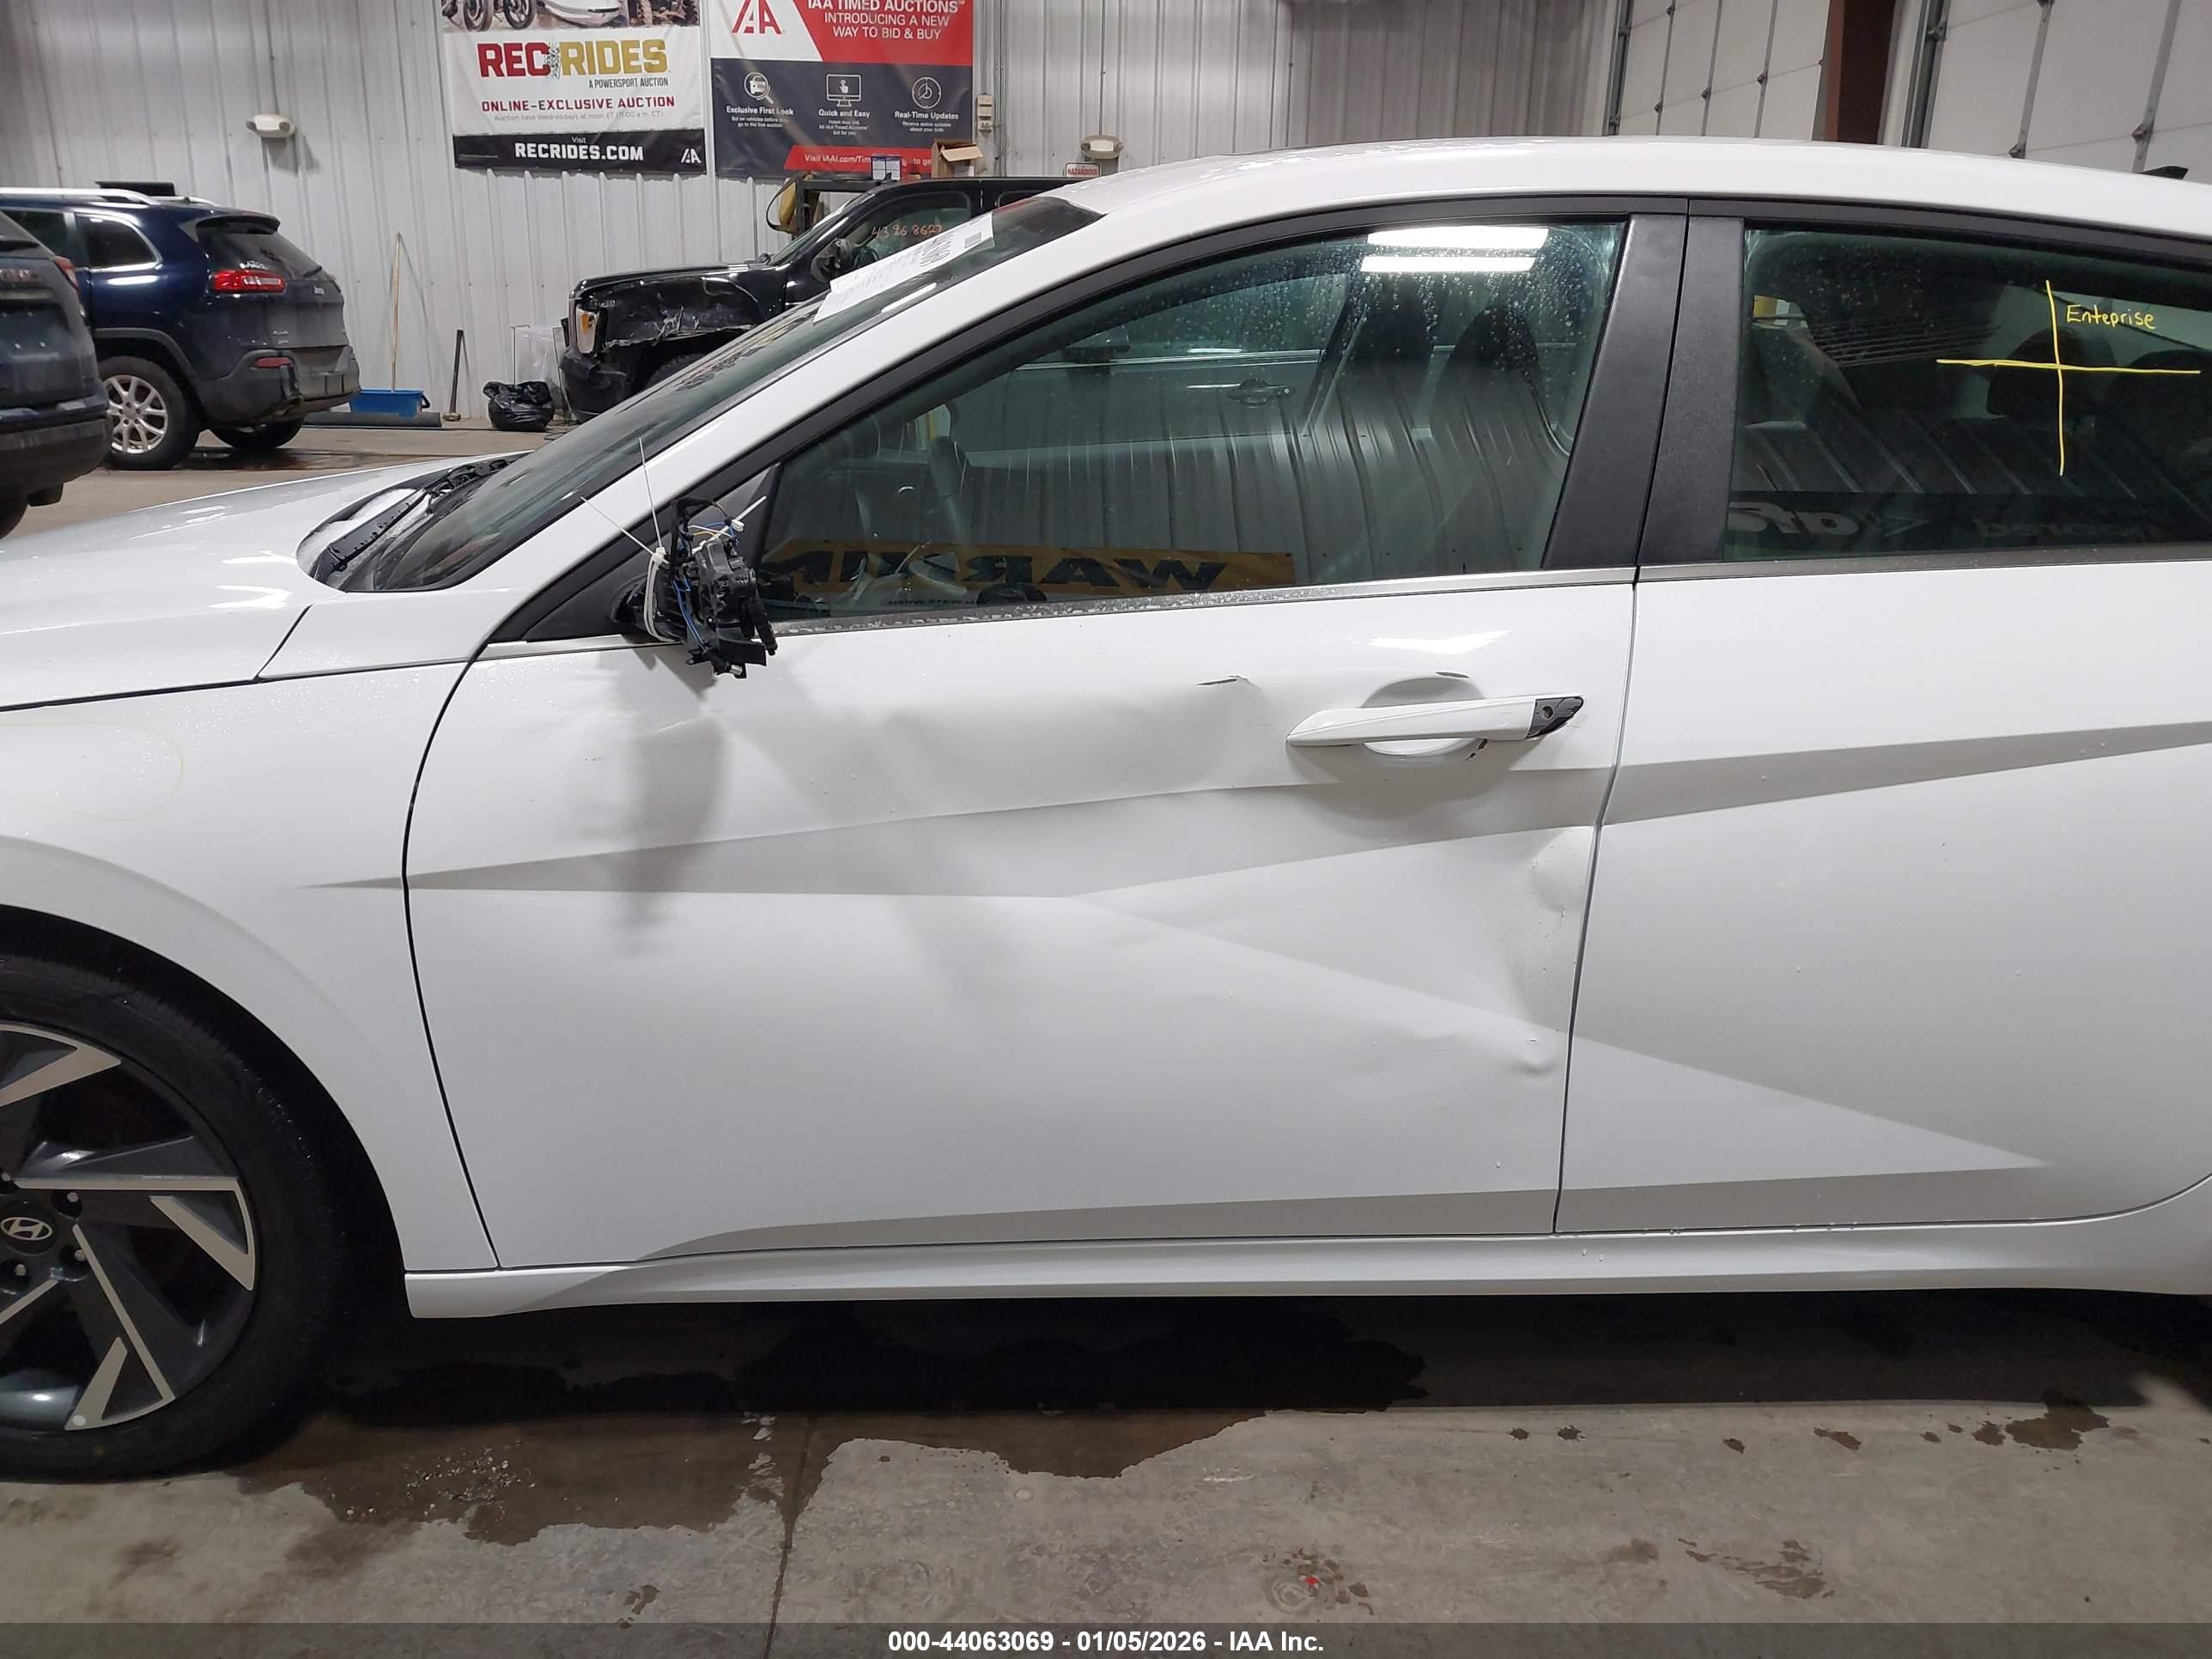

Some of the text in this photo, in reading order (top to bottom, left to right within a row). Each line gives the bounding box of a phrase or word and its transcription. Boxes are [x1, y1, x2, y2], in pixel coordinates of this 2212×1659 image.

[838, 0, 880, 11] TIMED
[884, 0, 958, 13] AUCTIONS
[824, 11, 949, 27] INTRODUCING A NEW
[832, 26, 942, 40] WAY TO BID & BUY
[588, 76, 668, 88] A POWERSPORT AUCTION
[482, 96, 674, 112] ONLINE-EXCLUSIVE AUCTION
[726, 106, 793, 116] Exclusive First Look
[818, 108, 838, 117] Quick
[854, 110, 871, 118] Easy
[894, 111, 928, 119] Real-Time
[514, 143, 644, 161] RECRIDES.COM
[805, 154, 821, 162] Visit
[2067, 304, 2156, 329] Enteprise
